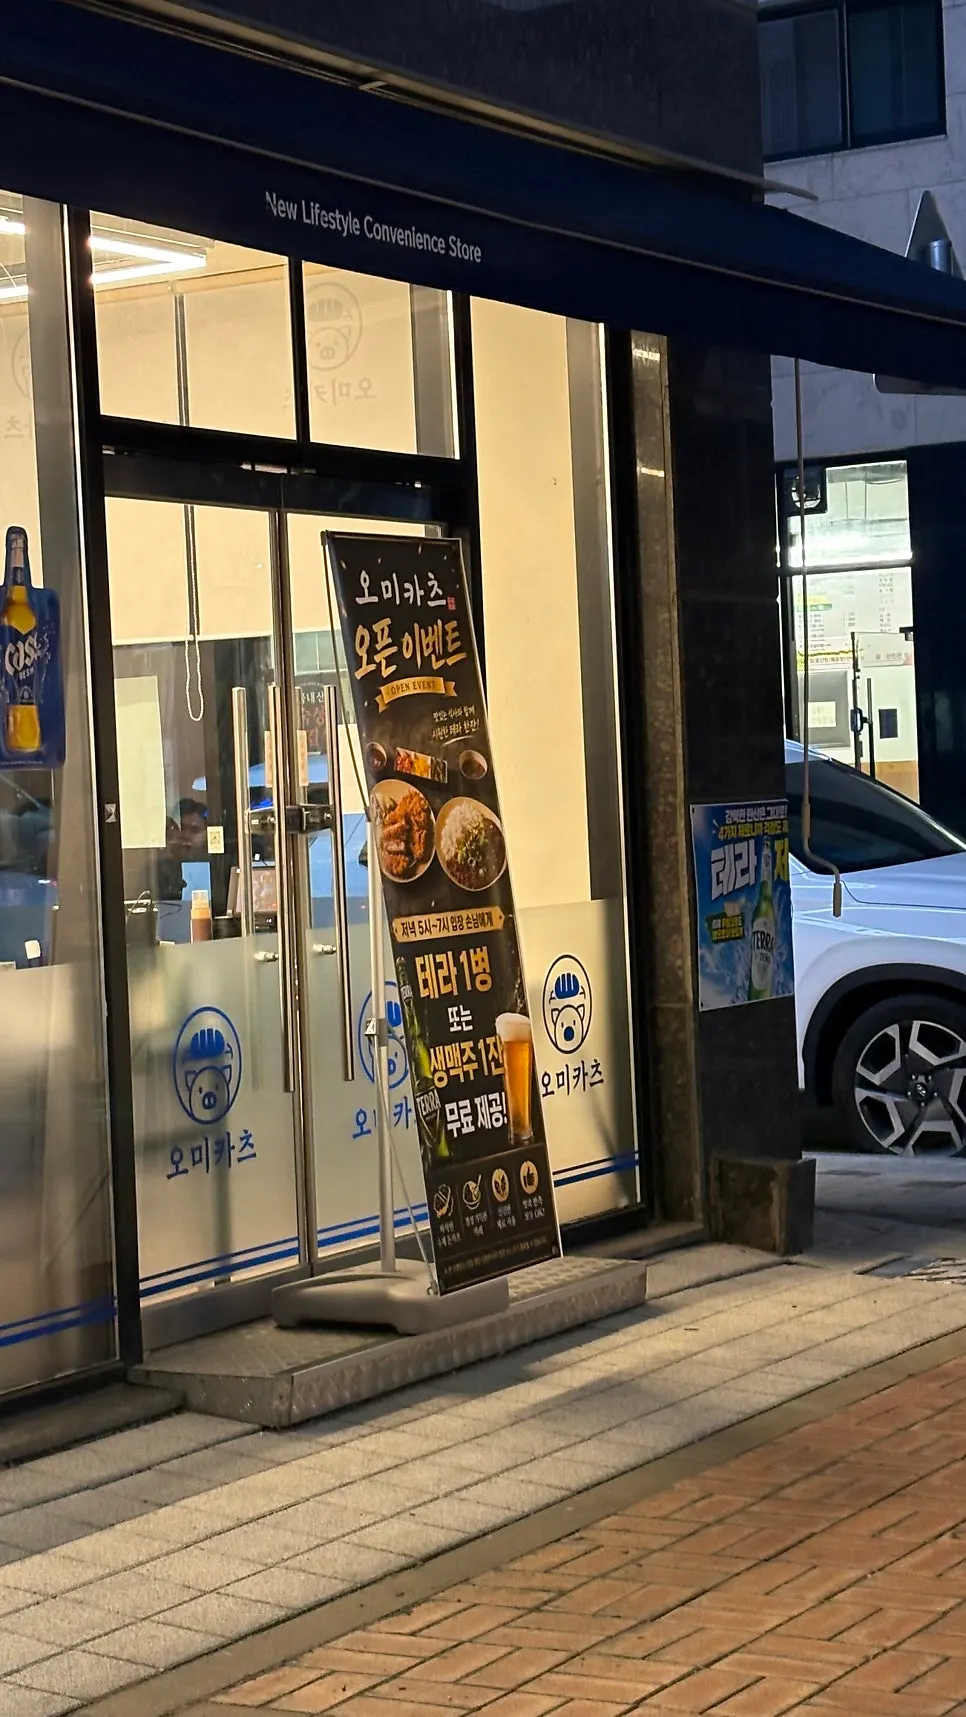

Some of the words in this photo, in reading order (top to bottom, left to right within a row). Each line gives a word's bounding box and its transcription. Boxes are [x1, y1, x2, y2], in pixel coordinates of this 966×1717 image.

[265, 191, 297, 220] New
[301, 199, 361, 237] Lifestyle
[363, 215, 445, 254] Convenience
[449, 235, 482, 262] Store
[355, 569, 447, 607] 오미카츠
[354, 617, 398, 680] 오픈
[402, 618, 467, 671] 이벤트
[391, 682, 411, 695] OPEN
[412, 680, 437, 690] EVENT
[711, 839, 758, 901] 테라
[401, 920, 416, 938] 저녁
[417, 915, 450, 936] 5시~7시
[450, 914, 464, 932] 입장
[465, 911, 494, 929] 손님에게
[415, 950, 459, 1000] 테라
[459, 945, 493, 992] 1병
[447, 1004, 474, 1033] 또는
[430, 1040, 479, 1089] 생맥주
[478, 1034, 505, 1076] 1잔
[541, 1058, 605, 1098] 오미카츠
[416, 1088, 442, 1117] TERRA
[444, 1099, 476, 1138] 무료
[474, 1091, 508, 1130] 제공!
[166, 1129, 257, 1180] 오미카츠
